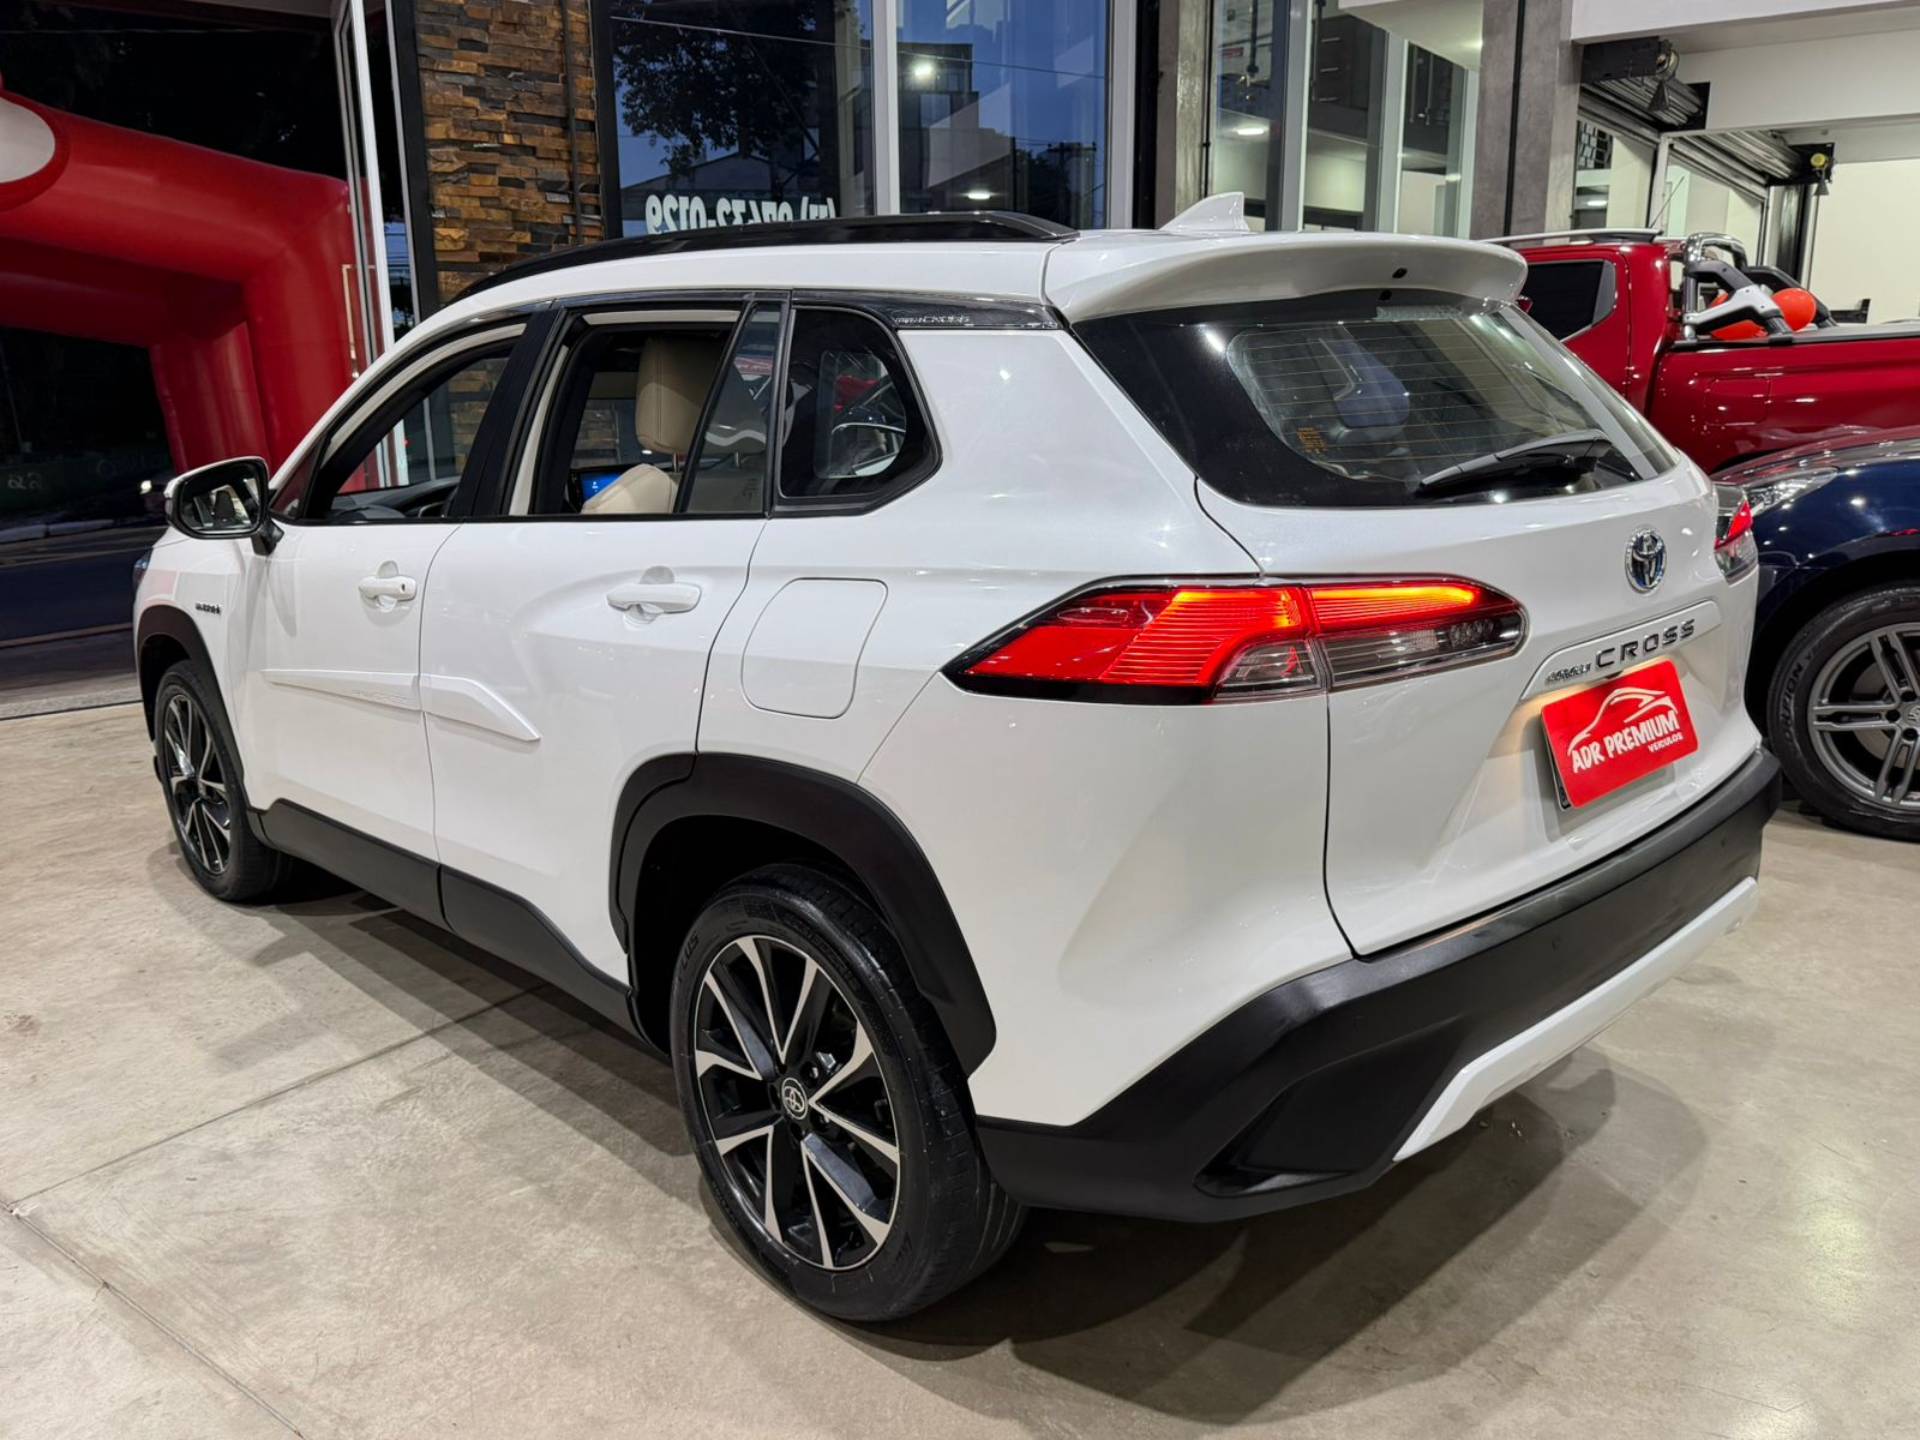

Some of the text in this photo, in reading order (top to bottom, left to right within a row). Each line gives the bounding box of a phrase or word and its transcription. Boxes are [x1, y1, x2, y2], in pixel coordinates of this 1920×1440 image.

[1595, 618, 1695, 668] CROSS
[1571, 710, 1680, 774] ADR PREMIUM
[1647, 731, 1684, 753] VEICULOS
